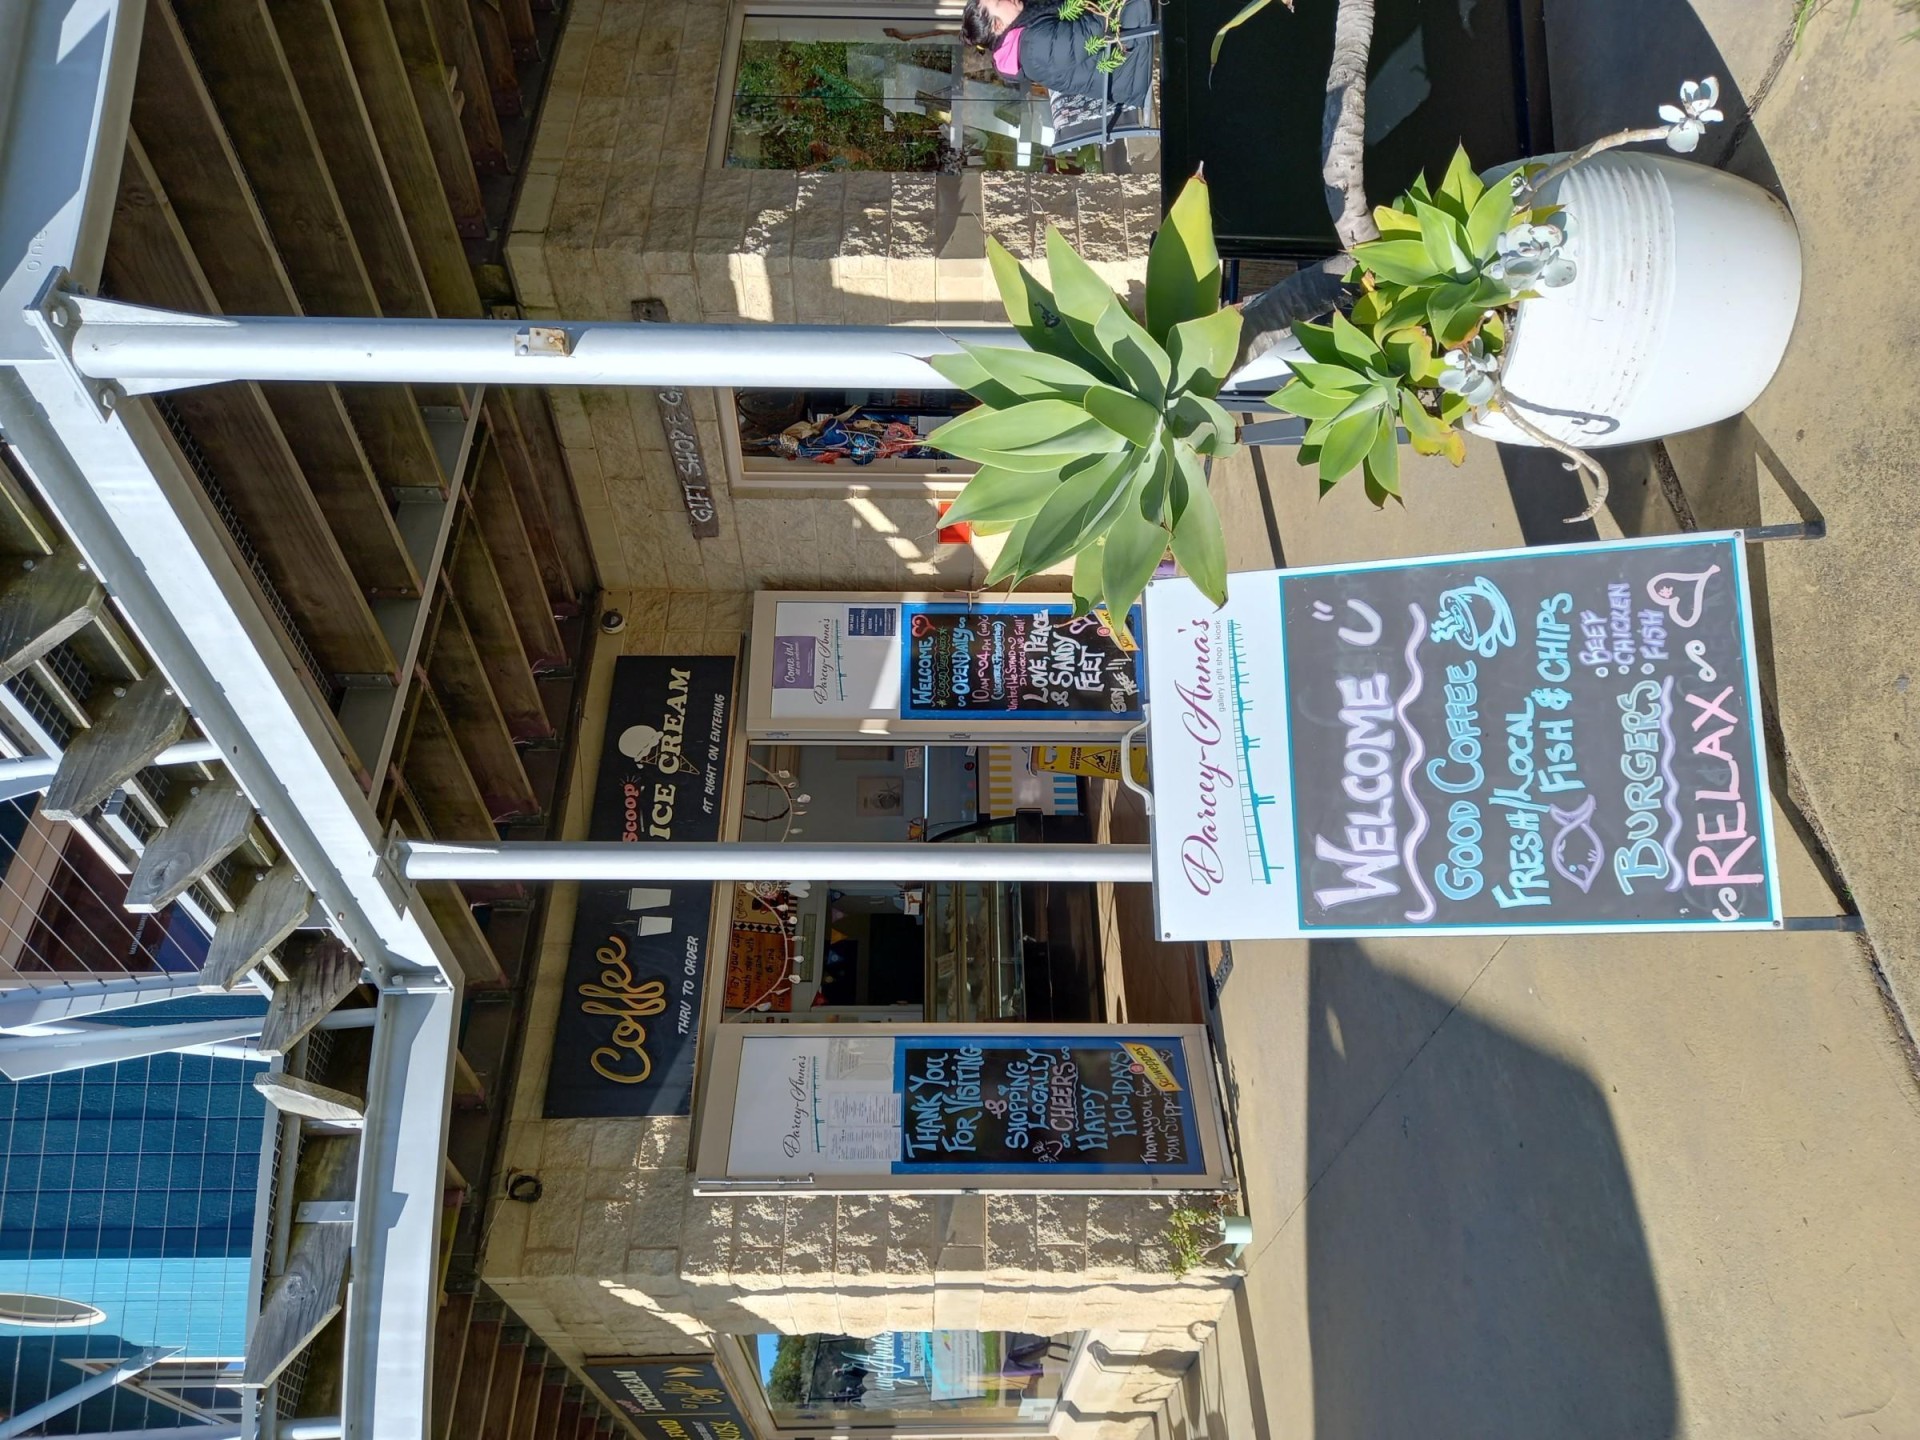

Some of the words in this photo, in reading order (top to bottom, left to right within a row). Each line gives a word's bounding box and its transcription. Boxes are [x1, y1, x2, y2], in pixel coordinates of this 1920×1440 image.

[665, 413, 689, 424] &
[670, 430, 703, 477] SHOP
[683, 483, 714, 523] GIFT
[1023, 610, 1050, 652] PEACE
[1213, 620, 1223, 640] kiosk
[1537, 592, 1574, 683] CHIPS
[1578, 610, 1613, 665] BEEF
[1607, 583, 1636, 665] CHICKEN
[1639, 609, 1670, 660] FISH
[782, 641, 795, 656] in!
[784, 658, 796, 683] Come
[814, 618, 835, 704] Darcey-Anna's
[912, 637, 934, 704] WELCOME
[1050, 632, 1081, 687] SANDY
[1075, 645, 1105, 691] FEET
[1214, 647, 1225, 666] shop
[1023, 657, 1051, 703] LOVE,
[1214, 667, 1225, 681] gift
[658, 668, 691, 775] CREAM
[710, 693, 726, 743] ENTERING
[1216, 686, 1227, 713] gallery
[1530, 688, 1573, 710] &
[1426, 660, 1485, 793] COFFEE
[708, 745, 720, 761] ON
[1069, 747, 1077, 770] CAUTION
[1174, 618, 1234, 896] Darcey-Anna's
[1538, 719, 1586, 792] FISH
[704, 763, 718, 796] RIGHT
[1313, 673, 1400, 909] WELCOME
[1613, 680, 1670, 895] BURGERS
[1685, 686, 1765, 886] RELAX
[622, 784, 640, 843] Scoop
[649, 783, 676, 840] ICE
[703, 797, 713, 814] AT
[1434, 801, 1485, 900] GOOD
[684, 935, 699, 976] ORDER
[578, 936, 667, 1083] Coffee
[682, 981, 695, 996] TO
[678, 1000, 691, 1035] THRU
[909, 1053, 950, 1092] YOU
[943, 1045, 985, 1113] VISITING
[1026, 1048, 1058, 1130] LOCALLY
[1132, 1047, 1175, 1088] Schweppes
[1135, 1078, 1153, 1097] for
[783, 1056, 810, 1158] Darcey-Anna's
[1003, 1062, 1030, 1149] SHOPPING
[1050, 1062, 1076, 1132] CHEERS
[1076, 1084, 1109, 1150] HAPPY
[1109, 1051, 1138, 1137] HOLIDAYS
[905, 1091, 947, 1158] THANK
[941, 1112, 983, 1153] FOR
[612, 1369, 667, 1411] ICECREAM
[658, 1380, 726, 1404] Coffee
[656, 1420, 689, 1438] FOOD
